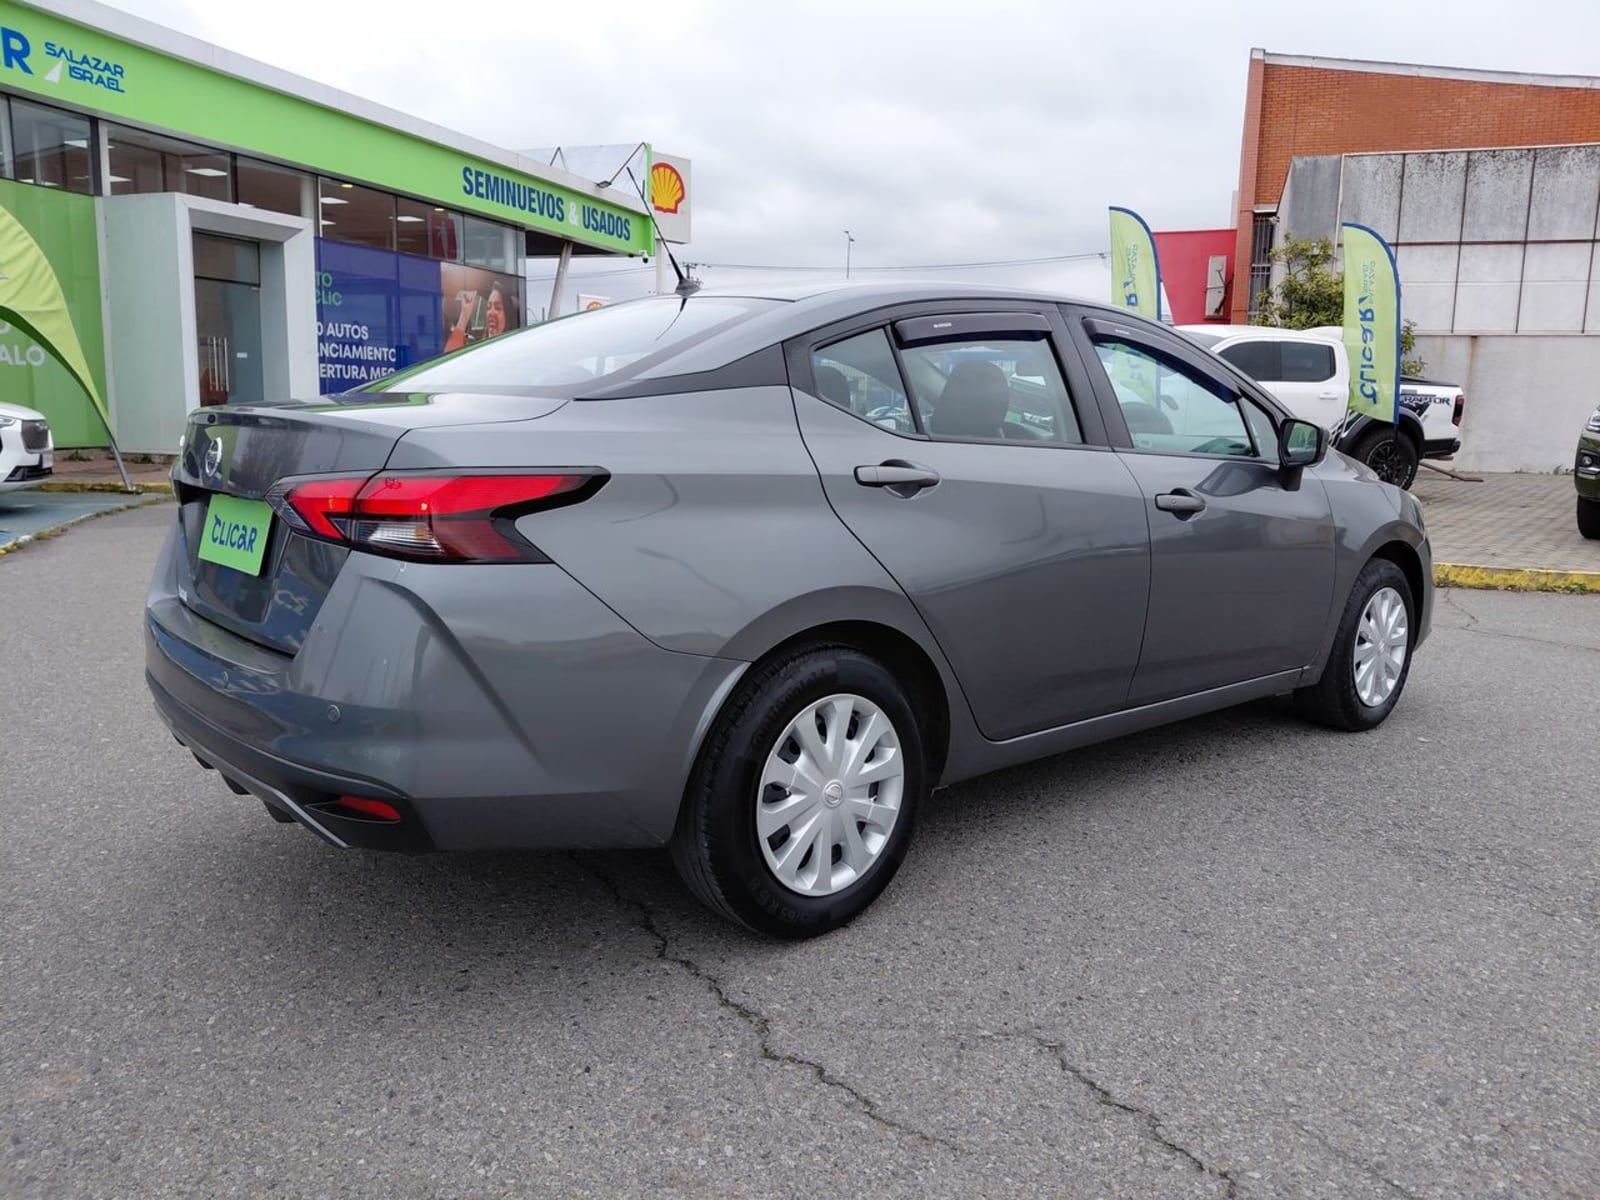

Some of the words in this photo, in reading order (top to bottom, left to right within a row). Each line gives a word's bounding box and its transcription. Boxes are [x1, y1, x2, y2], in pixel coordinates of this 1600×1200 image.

[44, 42, 125, 78] SALAZAR
[68, 66, 126, 93] ISRAEL
[462, 166, 565, 222] SEMINUEVOS
[568, 200, 579, 226] &
[582, 204, 631, 241] USADOS
[326, 322, 369, 340] AUTOS
[318, 343, 396, 362] NCIAMIENTO
[320, 363, 368, 380] ERTURA
[1403, 395, 1451, 407] RAPTOR
